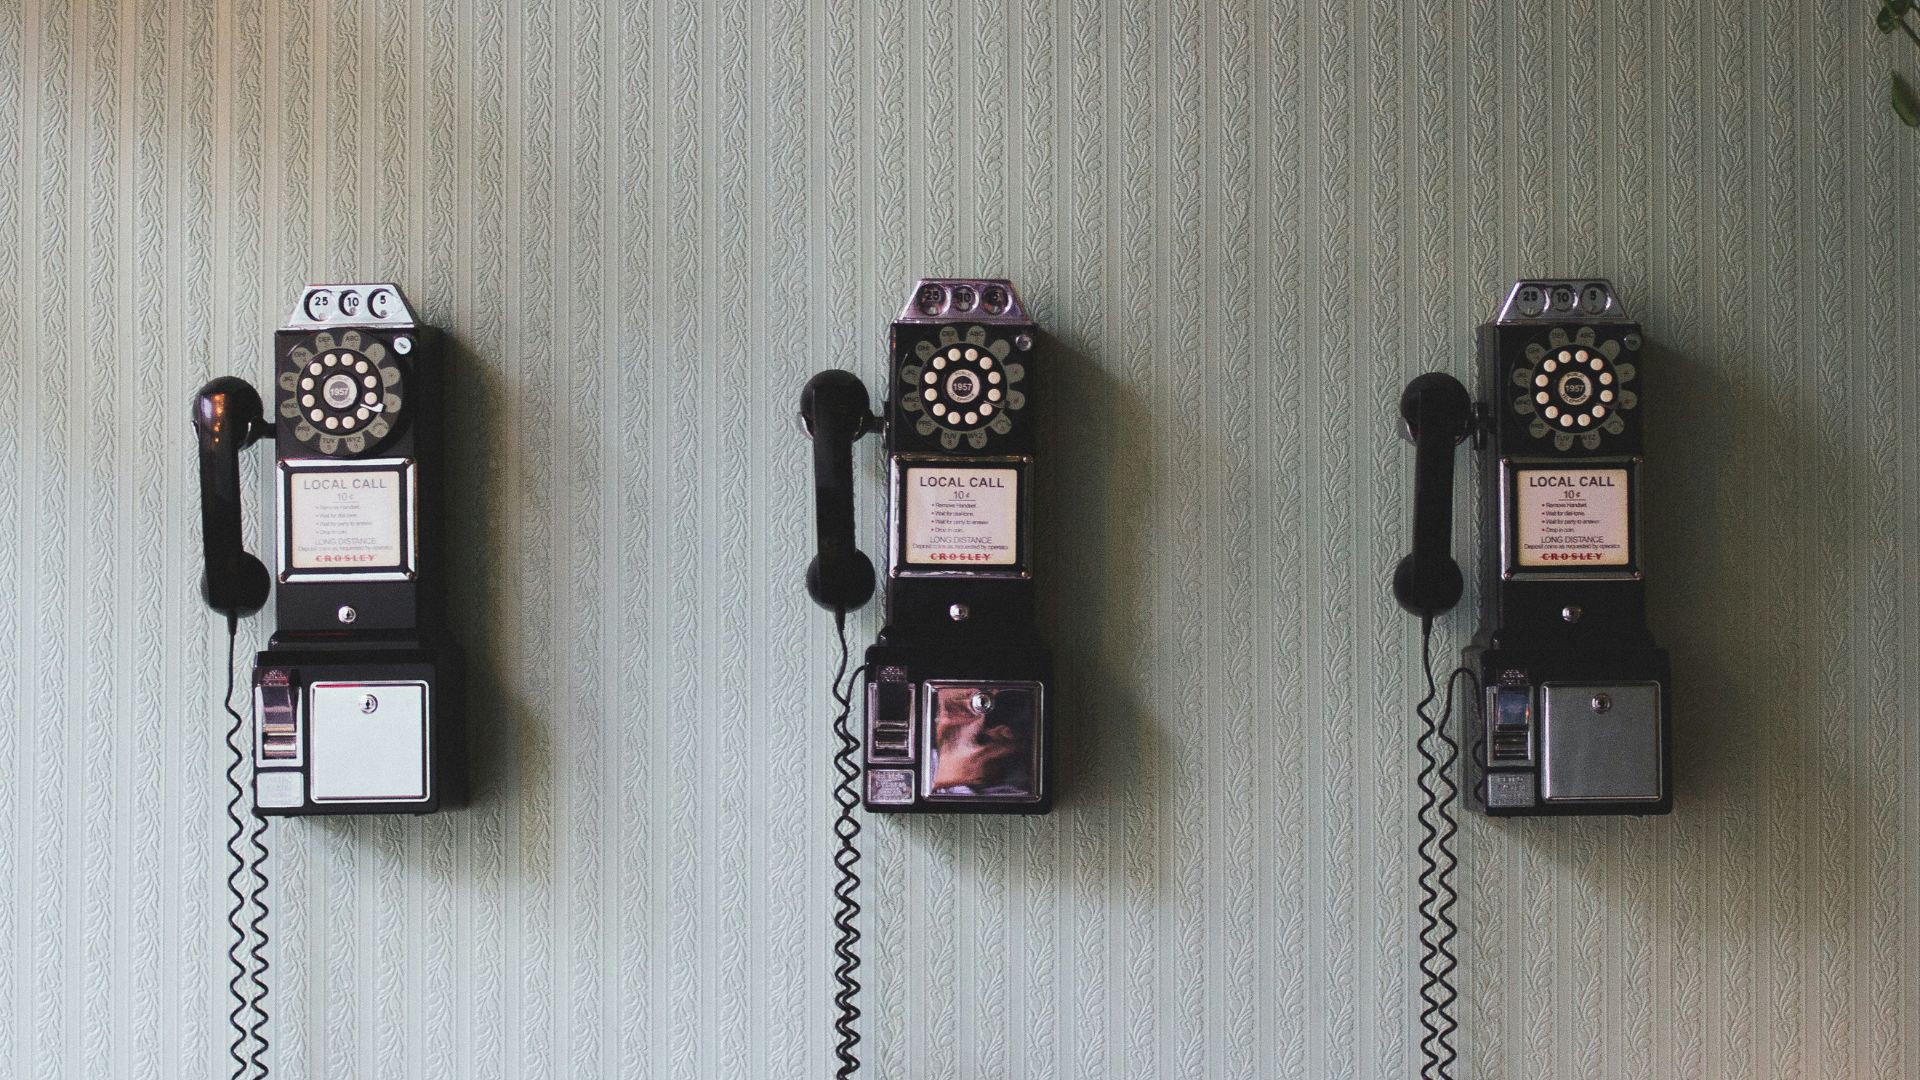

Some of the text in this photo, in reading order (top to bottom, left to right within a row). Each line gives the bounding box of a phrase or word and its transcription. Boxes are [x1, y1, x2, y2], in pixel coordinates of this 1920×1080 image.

[926, 290, 940, 300] 25
[1523, 290, 1597, 303] 25 10 5
[315, 295, 387, 307] 25 10 5
[330, 387, 349, 396] 1957
[953, 382, 973, 392] 1957
[1565, 384, 1585, 393] 1957
[303, 478, 387, 490] LOCAL CALL
[919, 476, 1005, 488] LOCAL CALL
[1529, 475, 1615, 488] LOCAL CALL
[315, 536, 377, 545] LONG DISTANCE
[929, 536, 993, 544] LONG DISTANCE
[1541, 535, 1605, 544] LONG DISTANCE
[316, 554, 376, 562] CROSLEY
[929, 553, 992, 561] CROSLEY
[1541, 553, 1603, 561] CROSLEY
